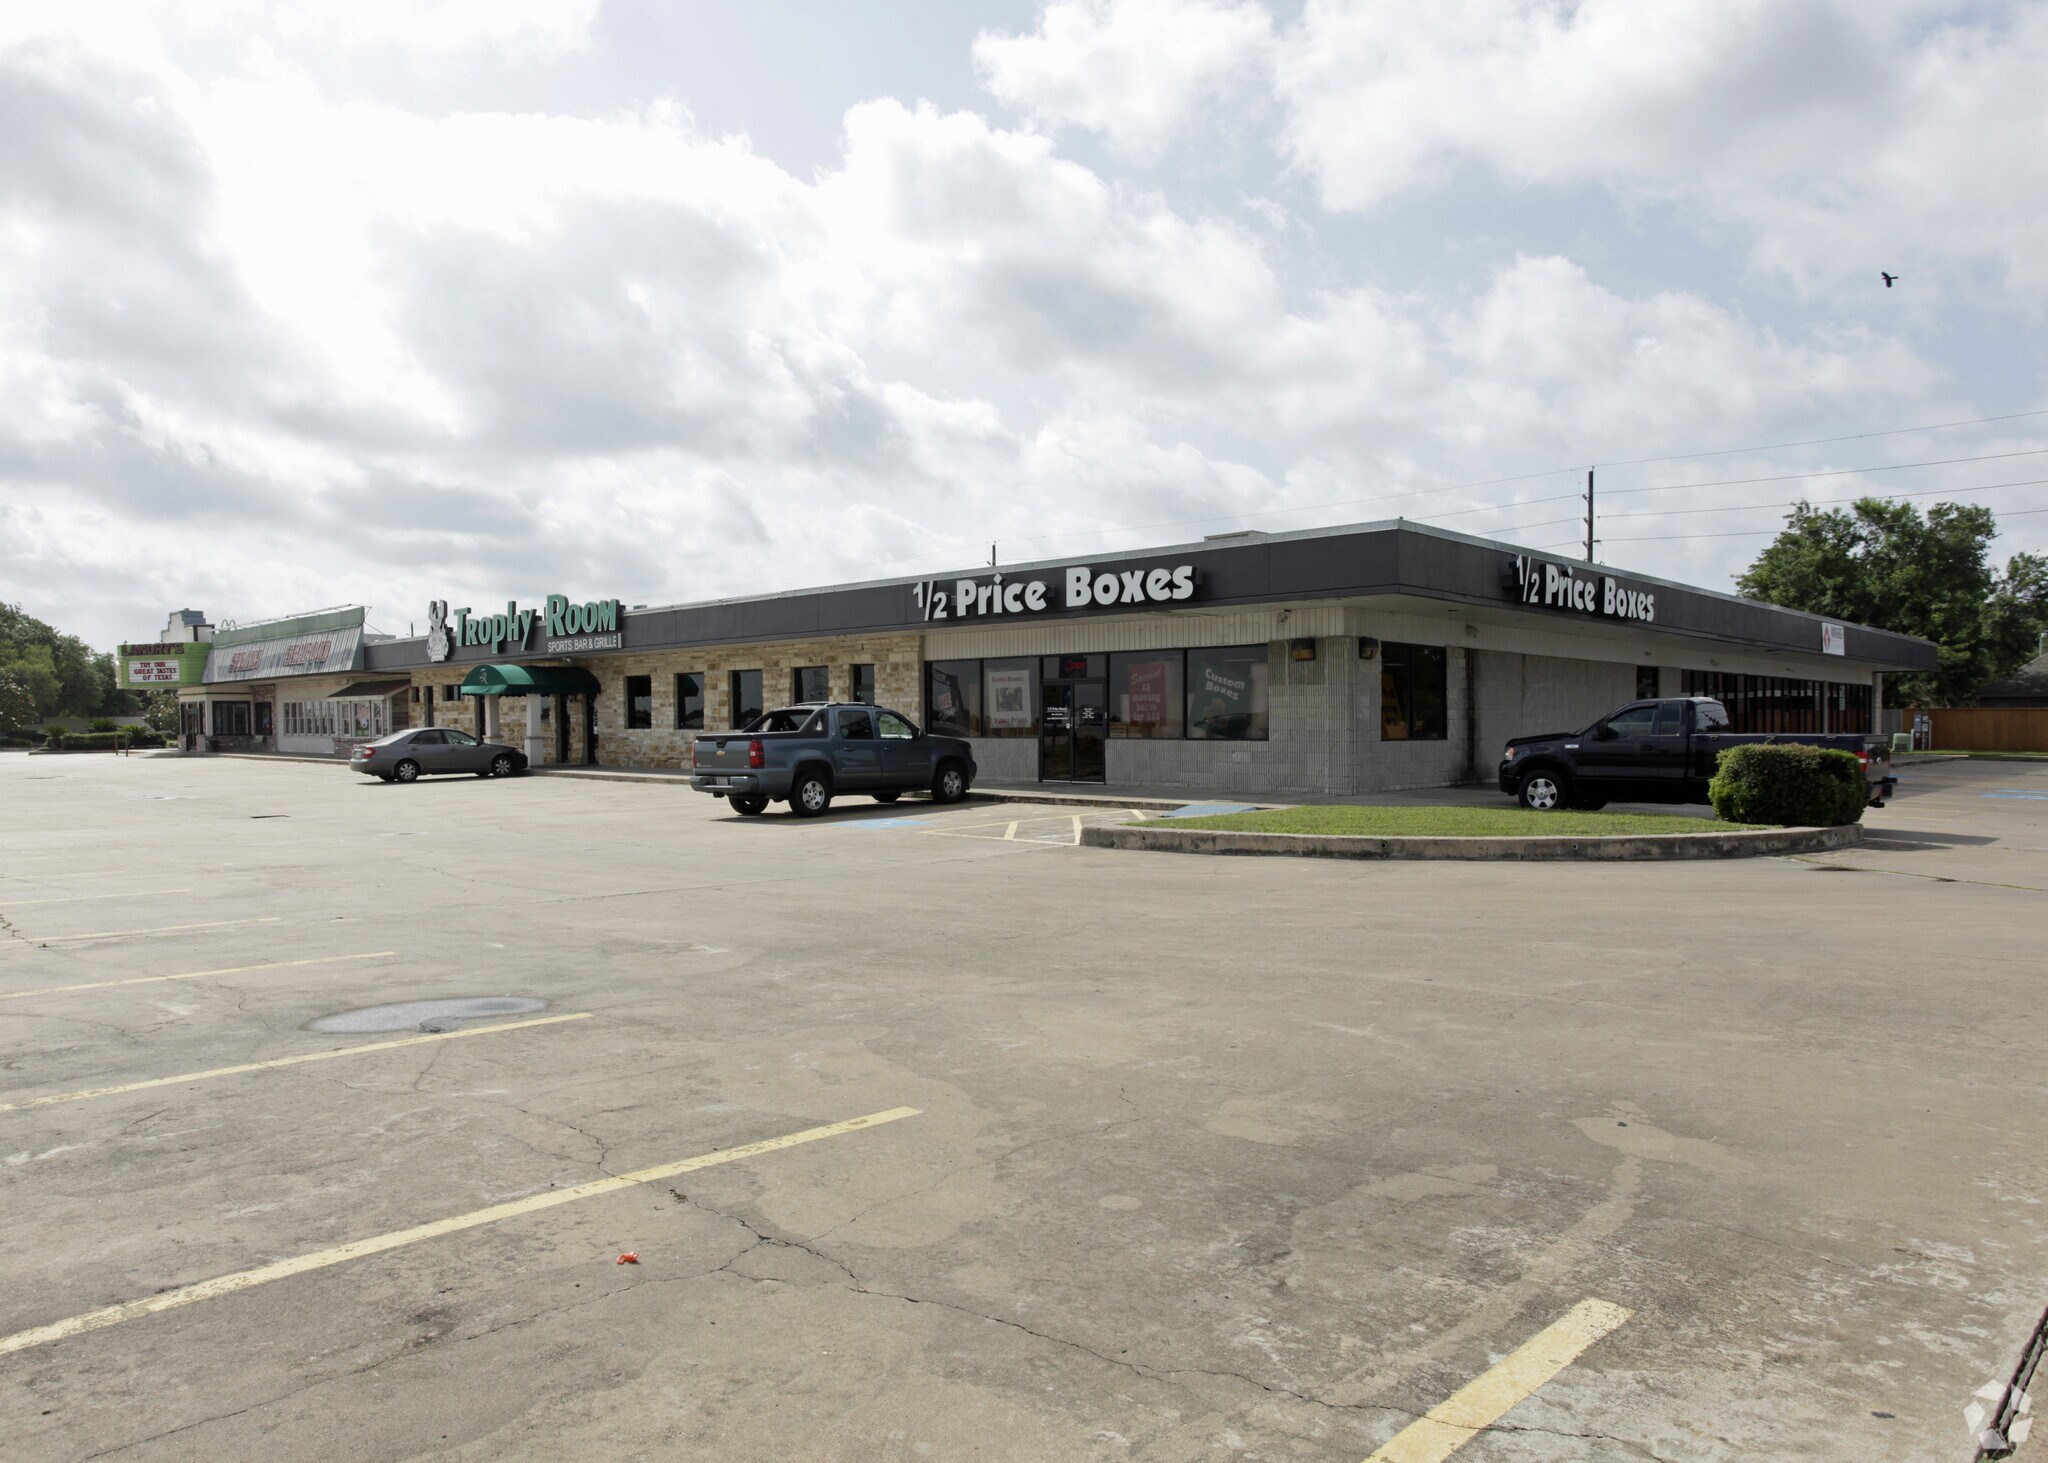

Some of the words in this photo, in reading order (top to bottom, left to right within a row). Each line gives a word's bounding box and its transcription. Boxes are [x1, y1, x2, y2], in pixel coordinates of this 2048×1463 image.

[956, 573, 1047, 617] Price
[1066, 565, 1194, 608] Boxes
[1545, 564, 1596, 612] Price
[1603, 576, 1654, 622] Boxes
[547, 640, 573, 652] SPORTS
[574, 639, 588, 650] BAR
[588, 638, 593, 649] &
[594, 635, 617, 649] GRILLE
[1205, 667, 1246, 690] Custom
[1205, 681, 1240, 701] Boxes
